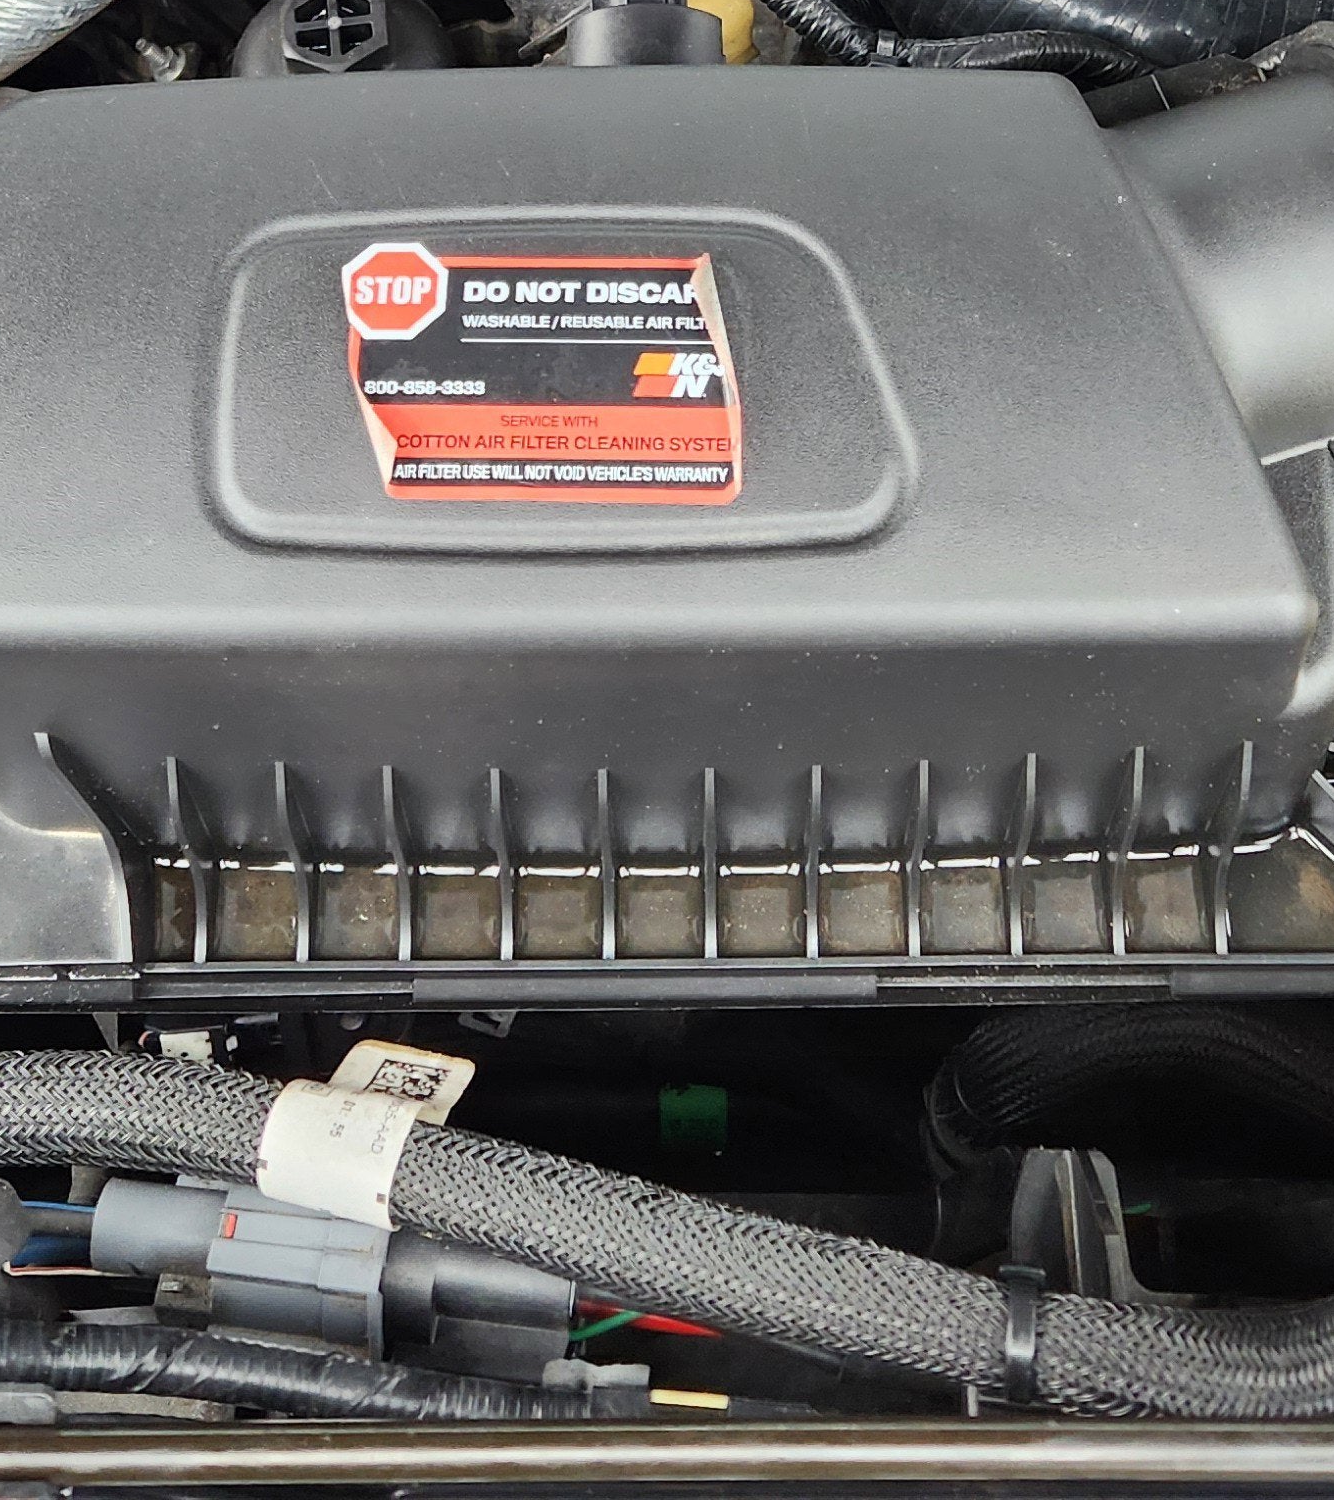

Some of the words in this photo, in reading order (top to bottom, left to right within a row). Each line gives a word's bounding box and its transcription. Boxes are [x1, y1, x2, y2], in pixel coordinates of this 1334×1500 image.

[355, 276, 431, 305] STOP
[463, 281, 510, 303] DO
[515, 281, 581, 304] NOT
[462, 315, 551, 329] WASHABLE
[560, 316, 644, 329] REUSABLE
[645, 316, 673, 330] AIR
[364, 380, 486, 395] 800-858-3333
[500, 415, 559, 427] SERVICE
[563, 416, 598, 427] WITH
[397, 434, 469, 449] COTTON
[475, 435, 505, 449] AIR
[510, 435, 568, 449] FILTER
[574, 436, 665, 451] CLEANING
[669, 437, 732, 451] SYSTE
[394, 464, 416, 479] AIR
[417, 464, 462, 480] FILTER
[463, 465, 491, 480] USE
[492, 465, 524, 480] WILL
[525, 465, 553, 481] NOT
[554, 465, 585, 481] VOID
[654, 467, 729, 483] WARRANTY
